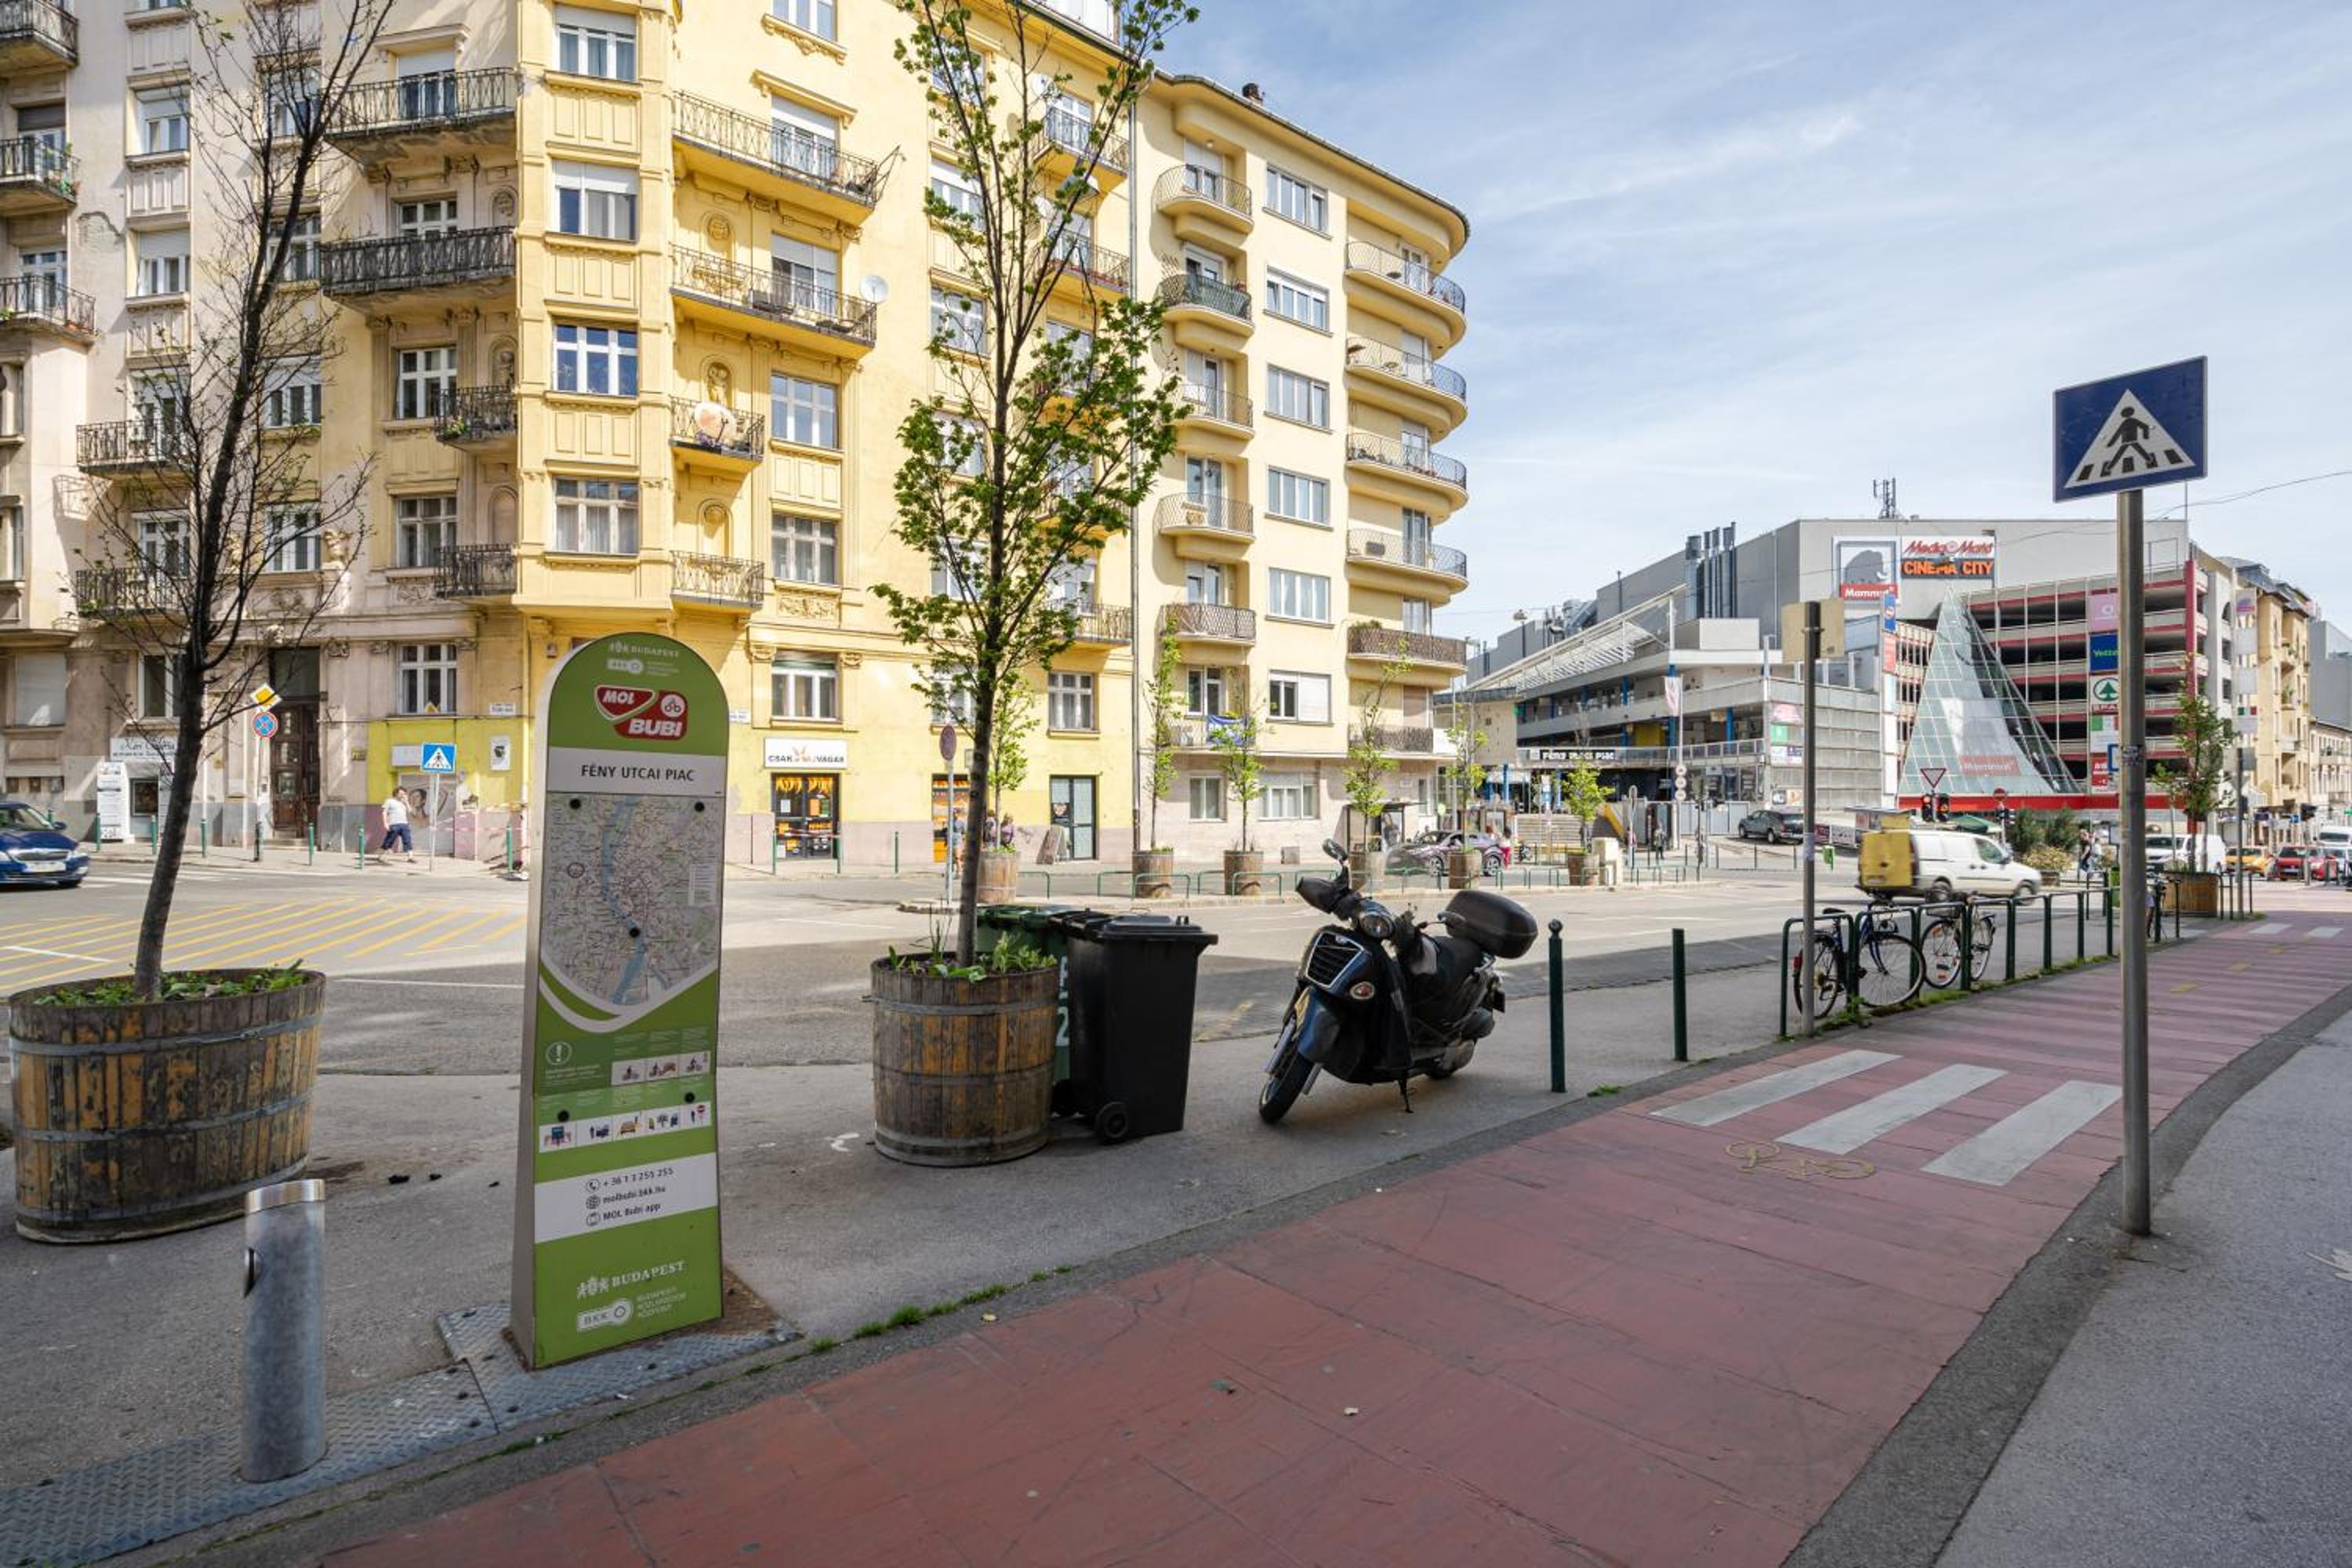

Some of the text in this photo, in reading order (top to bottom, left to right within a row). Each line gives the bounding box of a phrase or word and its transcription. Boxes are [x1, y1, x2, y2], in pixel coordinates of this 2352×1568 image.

[1904, 561, 1993, 575] CINEMA CITY
[602, 690, 634, 705] MOL
[628, 719, 683, 737] BUBI
[581, 762, 695, 782] FÉNY UTCAI PIAC
[611, 1260, 684, 1287] BUDAPEST
